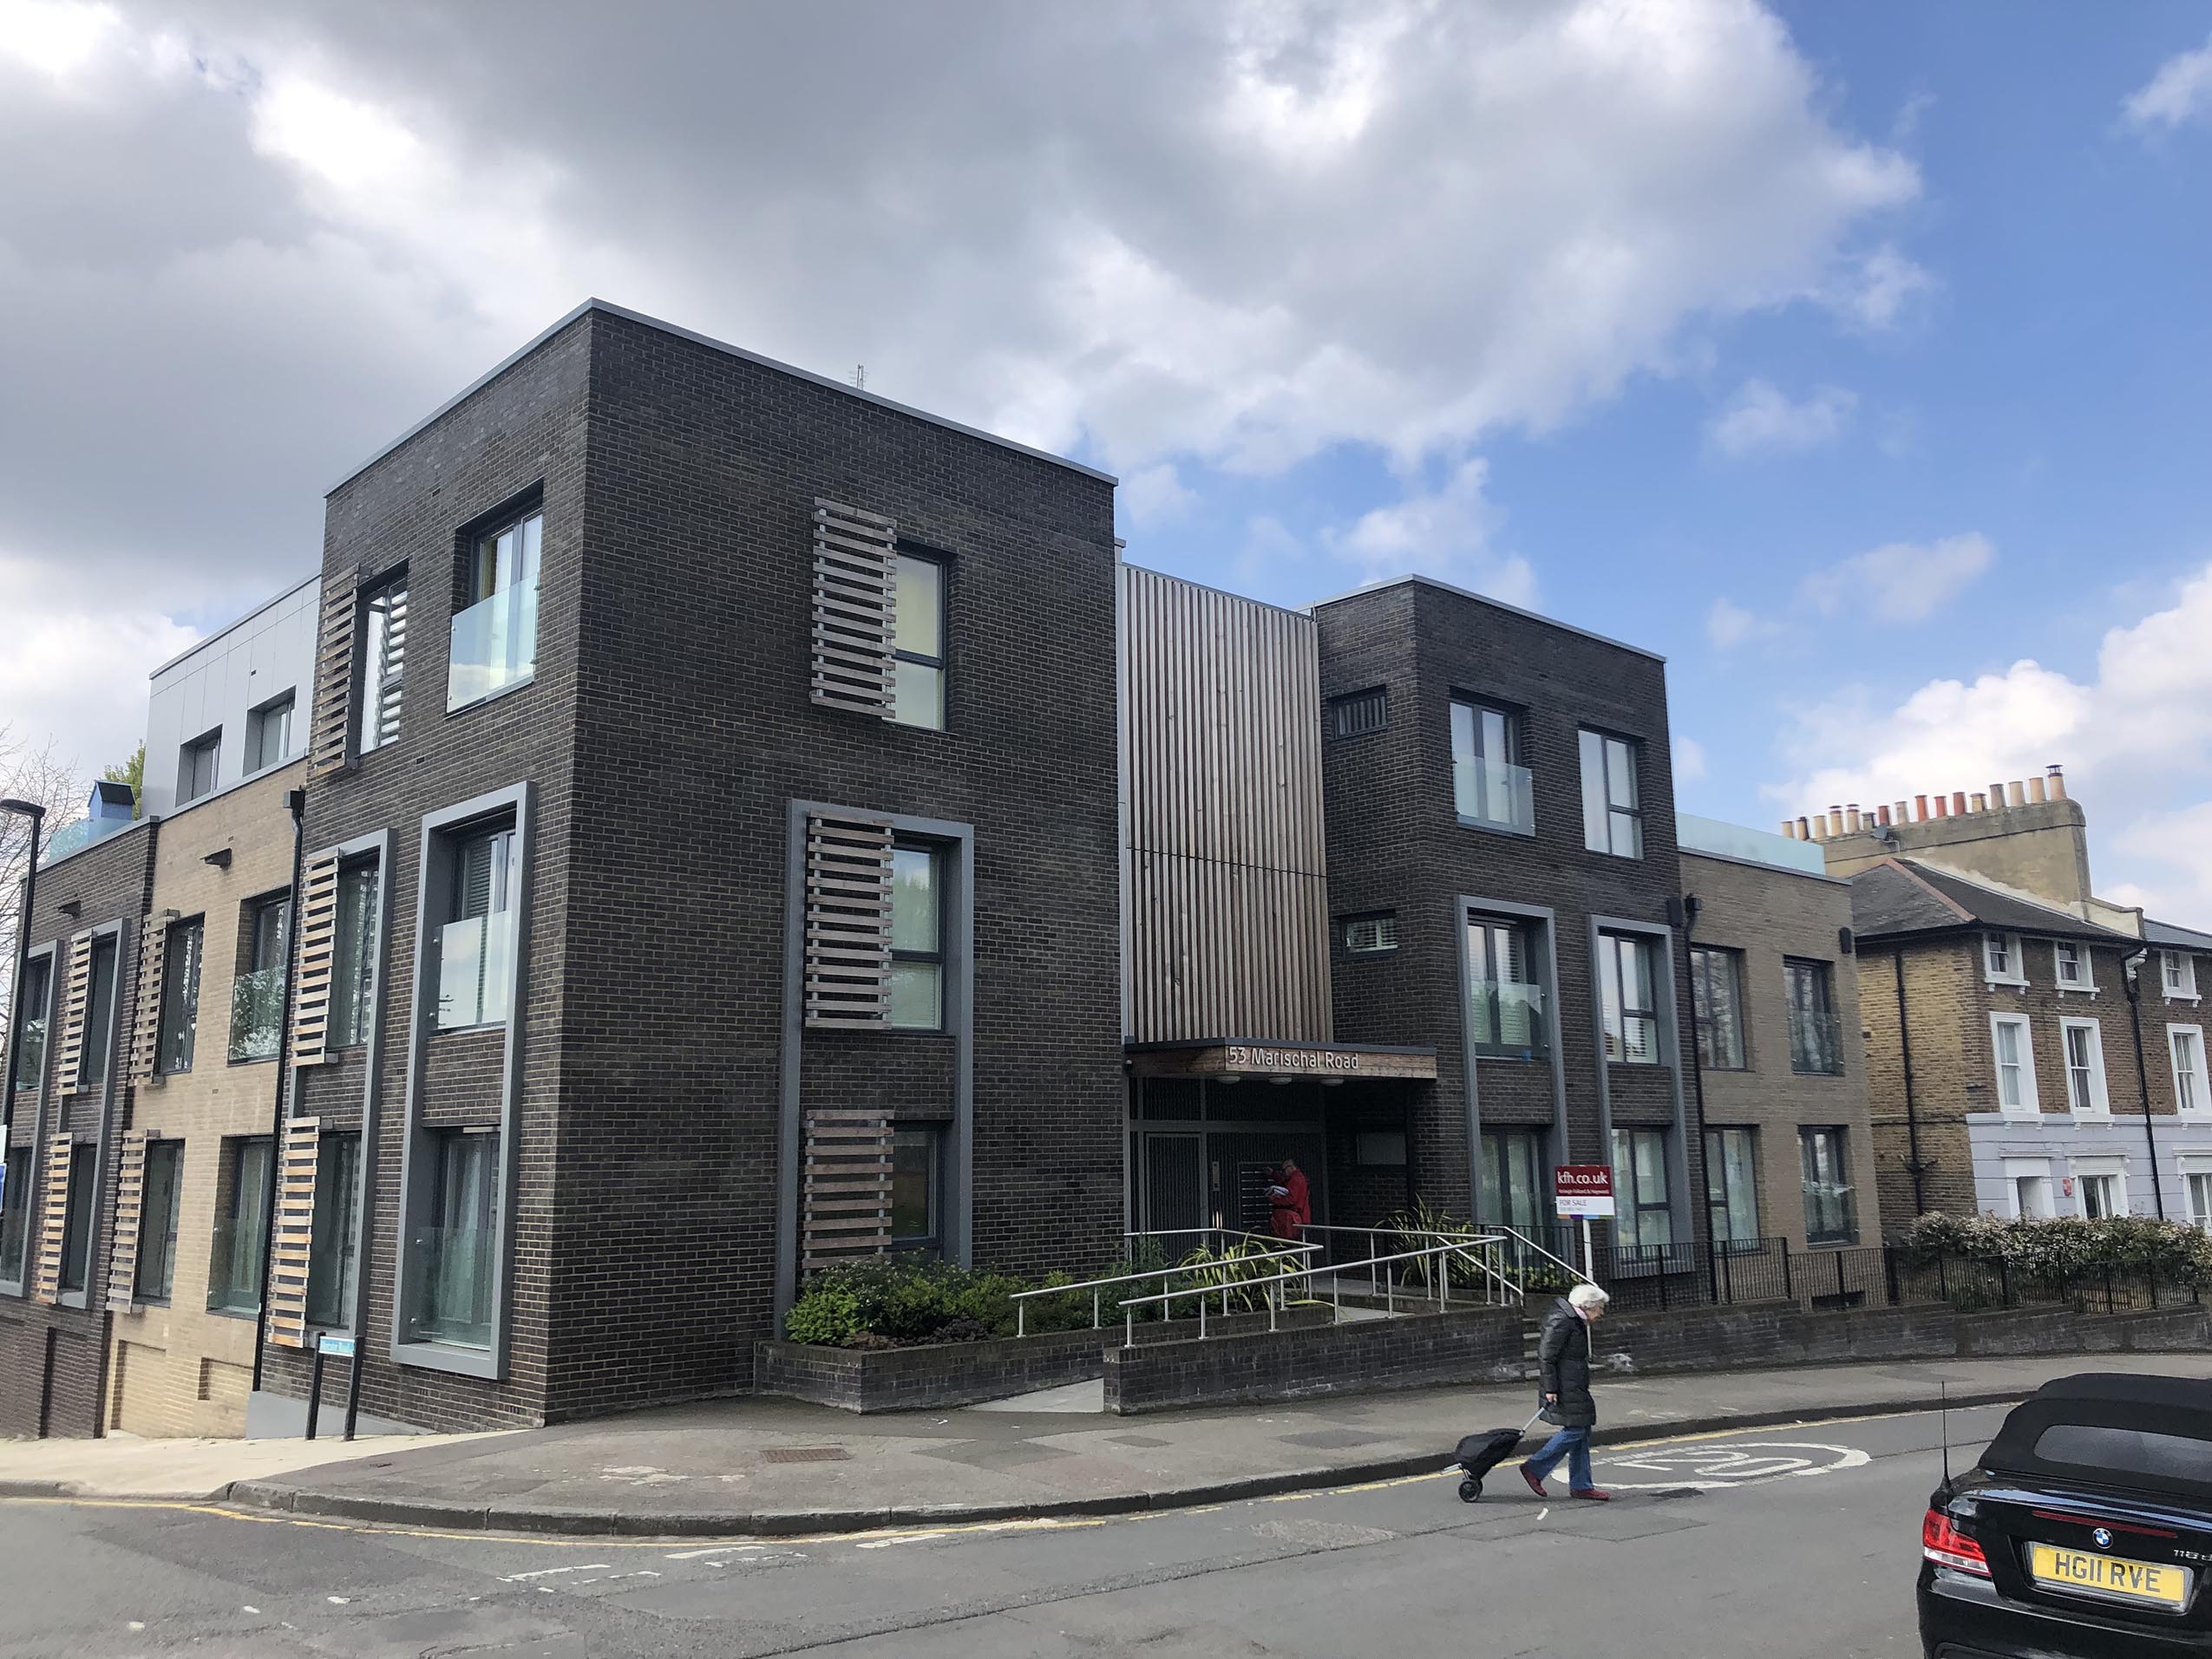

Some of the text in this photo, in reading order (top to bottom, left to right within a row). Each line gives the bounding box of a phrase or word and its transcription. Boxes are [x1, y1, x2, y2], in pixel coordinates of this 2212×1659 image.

[1229, 1046, 1359, 1069] 53 Marischal Road
[1556, 1171, 1608, 1184] kfh.co.uk
[2055, 1552, 2162, 1592] HG11 RVE
